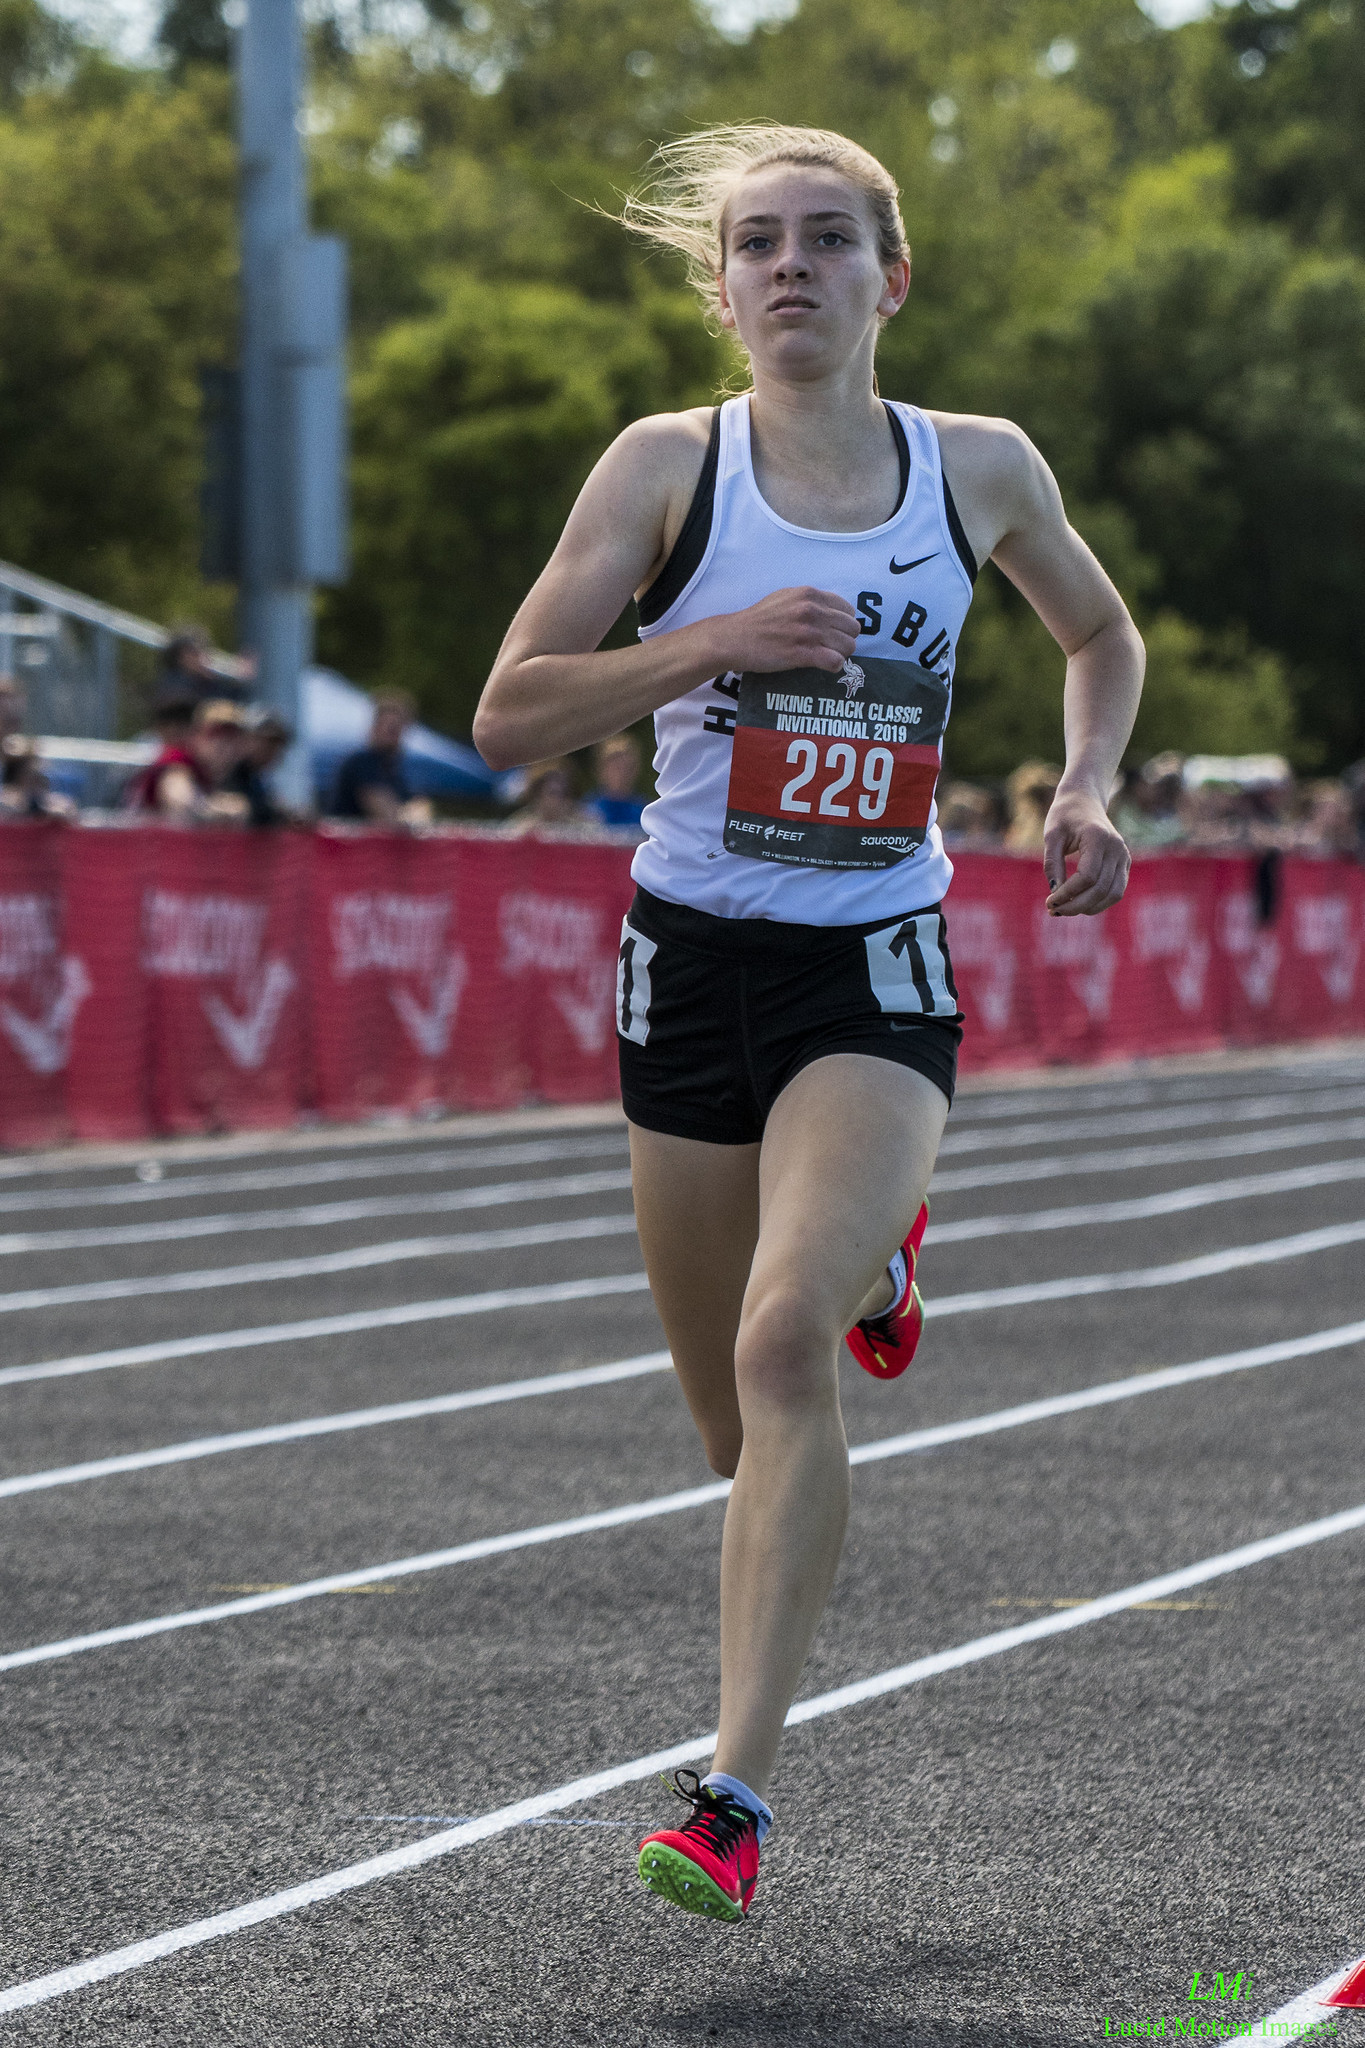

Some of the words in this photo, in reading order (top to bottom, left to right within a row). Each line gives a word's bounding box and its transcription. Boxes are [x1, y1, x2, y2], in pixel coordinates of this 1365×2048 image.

[766, 692, 813, 714] VIKING
[817, 697, 866, 720] TRACK
[868, 702, 923, 725] CLASSIC
[776, 713, 870, 740] INVITATIONAL
[873, 723, 907, 744] 2019
[779, 739, 895, 820] 229
[728, 820, 763, 835] FLEET
[775, 829, 805, 842] FEET
[860, 835, 909, 848] saucony
[888, 920, 936, 1013] 1
